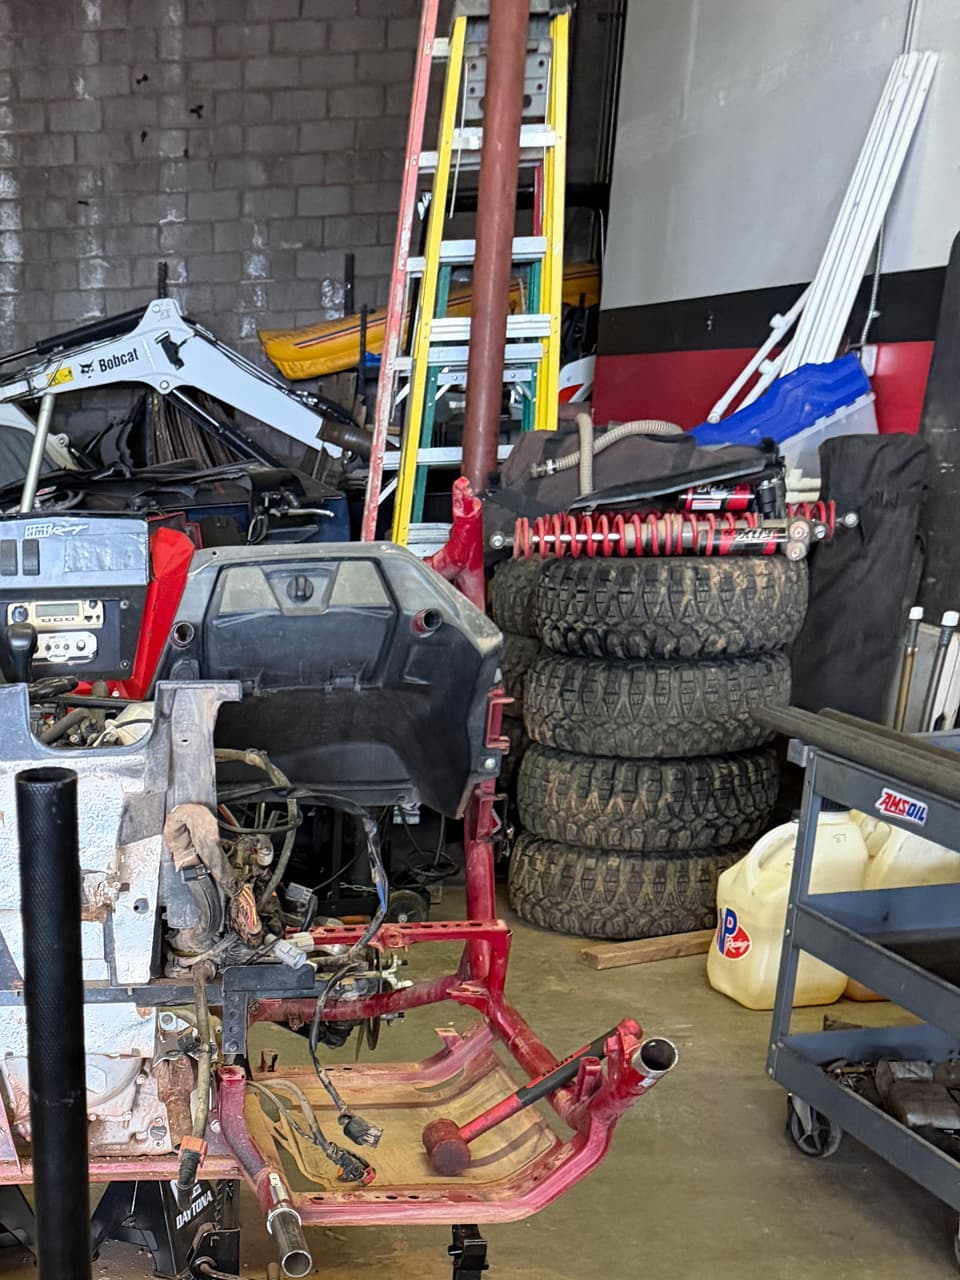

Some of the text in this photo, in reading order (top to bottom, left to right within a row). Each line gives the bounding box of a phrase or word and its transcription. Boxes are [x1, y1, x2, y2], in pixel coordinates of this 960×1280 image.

[98, 348, 139, 373] Bobcat
[878, 791, 926, 822] AMSOIL
[176, 1189, 214, 1230] DAYTONA
